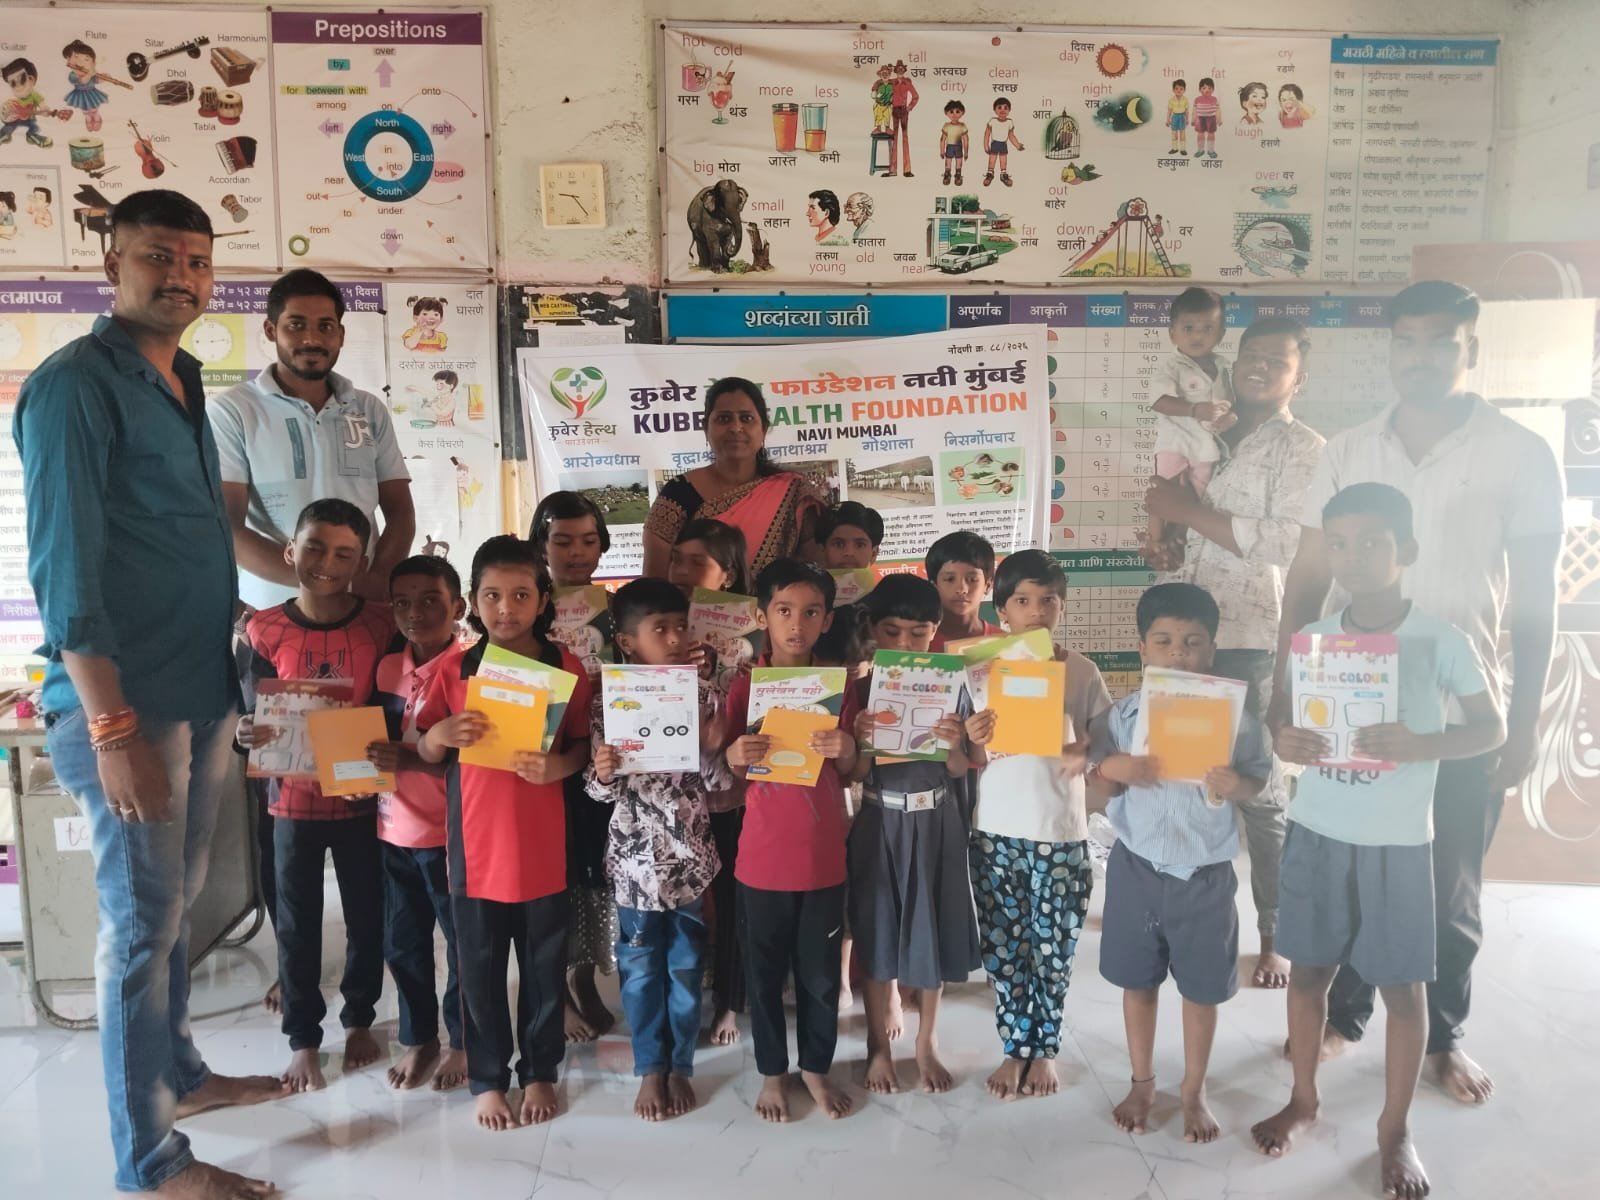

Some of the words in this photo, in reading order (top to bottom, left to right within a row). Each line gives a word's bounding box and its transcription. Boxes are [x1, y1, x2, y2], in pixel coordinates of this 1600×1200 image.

[85, 31, 107, 40] Flute
[315, 20, 447, 42] Prepositions
[145, 39, 164, 47] Sitar
[217, 34, 267, 42] Harmonium
[683, 34, 705, 47] hot
[1, 43, 27, 51] Guitar
[852, 38, 884, 50] short
[1071, 41, 1095, 51] दिवस
[714, 44, 743, 56] cold
[1278, 49, 1294, 60] cry
[853, 55, 879, 68] बुटका
[908, 52, 927, 63] tall
[1059, 50, 1080, 64] day
[333, 60, 344, 68] by
[167, 69, 187, 78] Dhol
[933, 67, 968, 76] अस्वच्छ
[989, 67, 1019, 78] clean
[1163, 67, 1184, 77] thin
[1211, 67, 1226, 79] fat
[286, 86, 298, 95] for
[306, 86, 344, 95] between
[349, 86, 367, 95] with
[759, 85, 794, 96] more
[815, 85, 839, 98] less
[941, 80, 967, 93] dirty
[992, 84, 1018, 93] स्वच्छ
[1082, 84, 1113, 96] night
[678, 95, 700, 106] गरम
[1042, 96, 1052, 107] in
[316, 102, 347, 111] among
[194, 123, 216, 131] Tabla
[325, 124, 339, 132] left
[375, 119, 399, 127] North
[432, 125, 452, 134] right
[1234, 127, 1263, 139] laugh
[147, 135, 170, 143] Violin
[345, 153, 365, 162] West
[414, 153, 434, 162] East
[768, 156, 797, 168] जास्त
[819, 152, 840, 164] कमी
[694, 160, 714, 176] big
[718, 160, 740, 173] मोठा
[434, 169, 463, 178] behind
[1255, 170, 1280, 180] over
[99, 180, 122, 189] Drum
[208, 176, 250, 184] Accordian
[376, 187, 402, 195] South
[1048, 185, 1067, 195] out
[239, 195, 262, 203] Tabor
[1044, 198, 1066, 209] बाहेर
[378, 207, 402, 215] under
[751, 200, 784, 212] small
[763, 217, 790, 228] लहान
[310, 226, 330, 234] from
[1022, 224, 1037, 235] far
[1056, 223, 1095, 236] down
[380, 232, 403, 240] down
[228, 241, 260, 250] Clarinet
[1057, 239, 1087, 251] खाली
[1165, 239, 1182, 253] up
[72, 249, 96, 257] Piano
[856, 252, 874, 263] old
[809, 262, 846, 276] young
[902, 263, 927, 274] near
[237, 287, 250, 296] ५२
[355, 285, 379, 296] दिवस
[466, 290, 483, 300] दात
[237, 301, 249, 310] ५२
[355, 300, 378, 311] दिवस
[1029, 302, 1068, 317] आकृती
[1090, 305, 1121, 317] संख्या
[745, 308, 821, 327] शब्दांच्या
[826, 304, 870, 327] जाती
[957, 304, 1002, 320] अपूर्णांक
[222, 373, 242, 381] three
[629, 380, 697, 409] कुबेर
[770, 372, 896, 396] फाउंडेशन
[903, 365, 957, 388] नवी
[964, 360, 1027, 391] मुंबई
[634, 411, 706, 434] KUBE
[852, 392, 1027, 421] FOUNDATION
[548, 421, 580, 440] कुबेर
[583, 422, 616, 435] हेल्थ
[797, 428, 832, 441] NAVI
[836, 424, 897, 439] MUMBAI
[944, 430, 1015, 447] निसर्गोपचार
[563, 454, 640, 468] आरोग्यधाम
[1077, 556, 1103, 567] आणि
[1300, 672, 1324, 682] FUN
[1339, 672, 1389, 683] COLOUR
[879, 682, 900, 691] FUN
[912, 683, 952, 693] COLOUR
